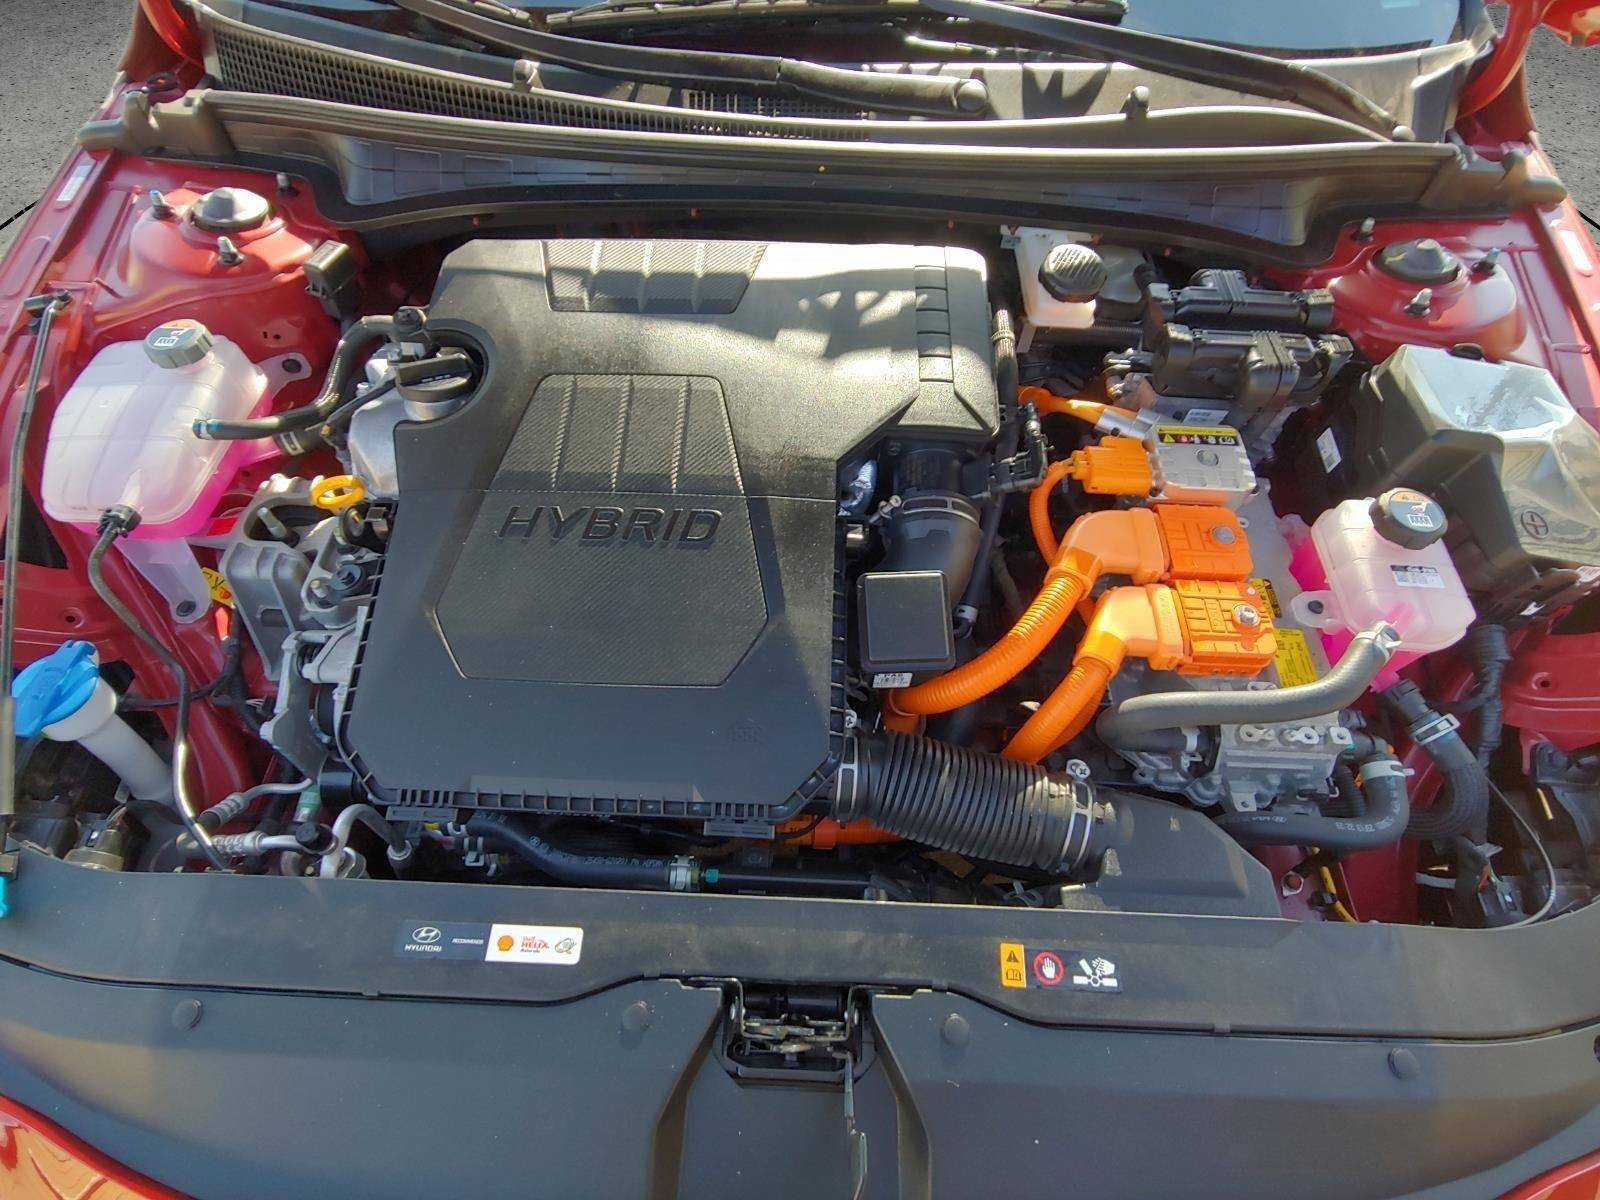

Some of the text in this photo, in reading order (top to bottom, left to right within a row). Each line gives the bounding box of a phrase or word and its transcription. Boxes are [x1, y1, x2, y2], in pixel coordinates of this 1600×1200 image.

[497, 505, 723, 543] HYBRID
[404, 944, 442, 952] HYUNDAI
[521, 940, 549, 949] HELIX
